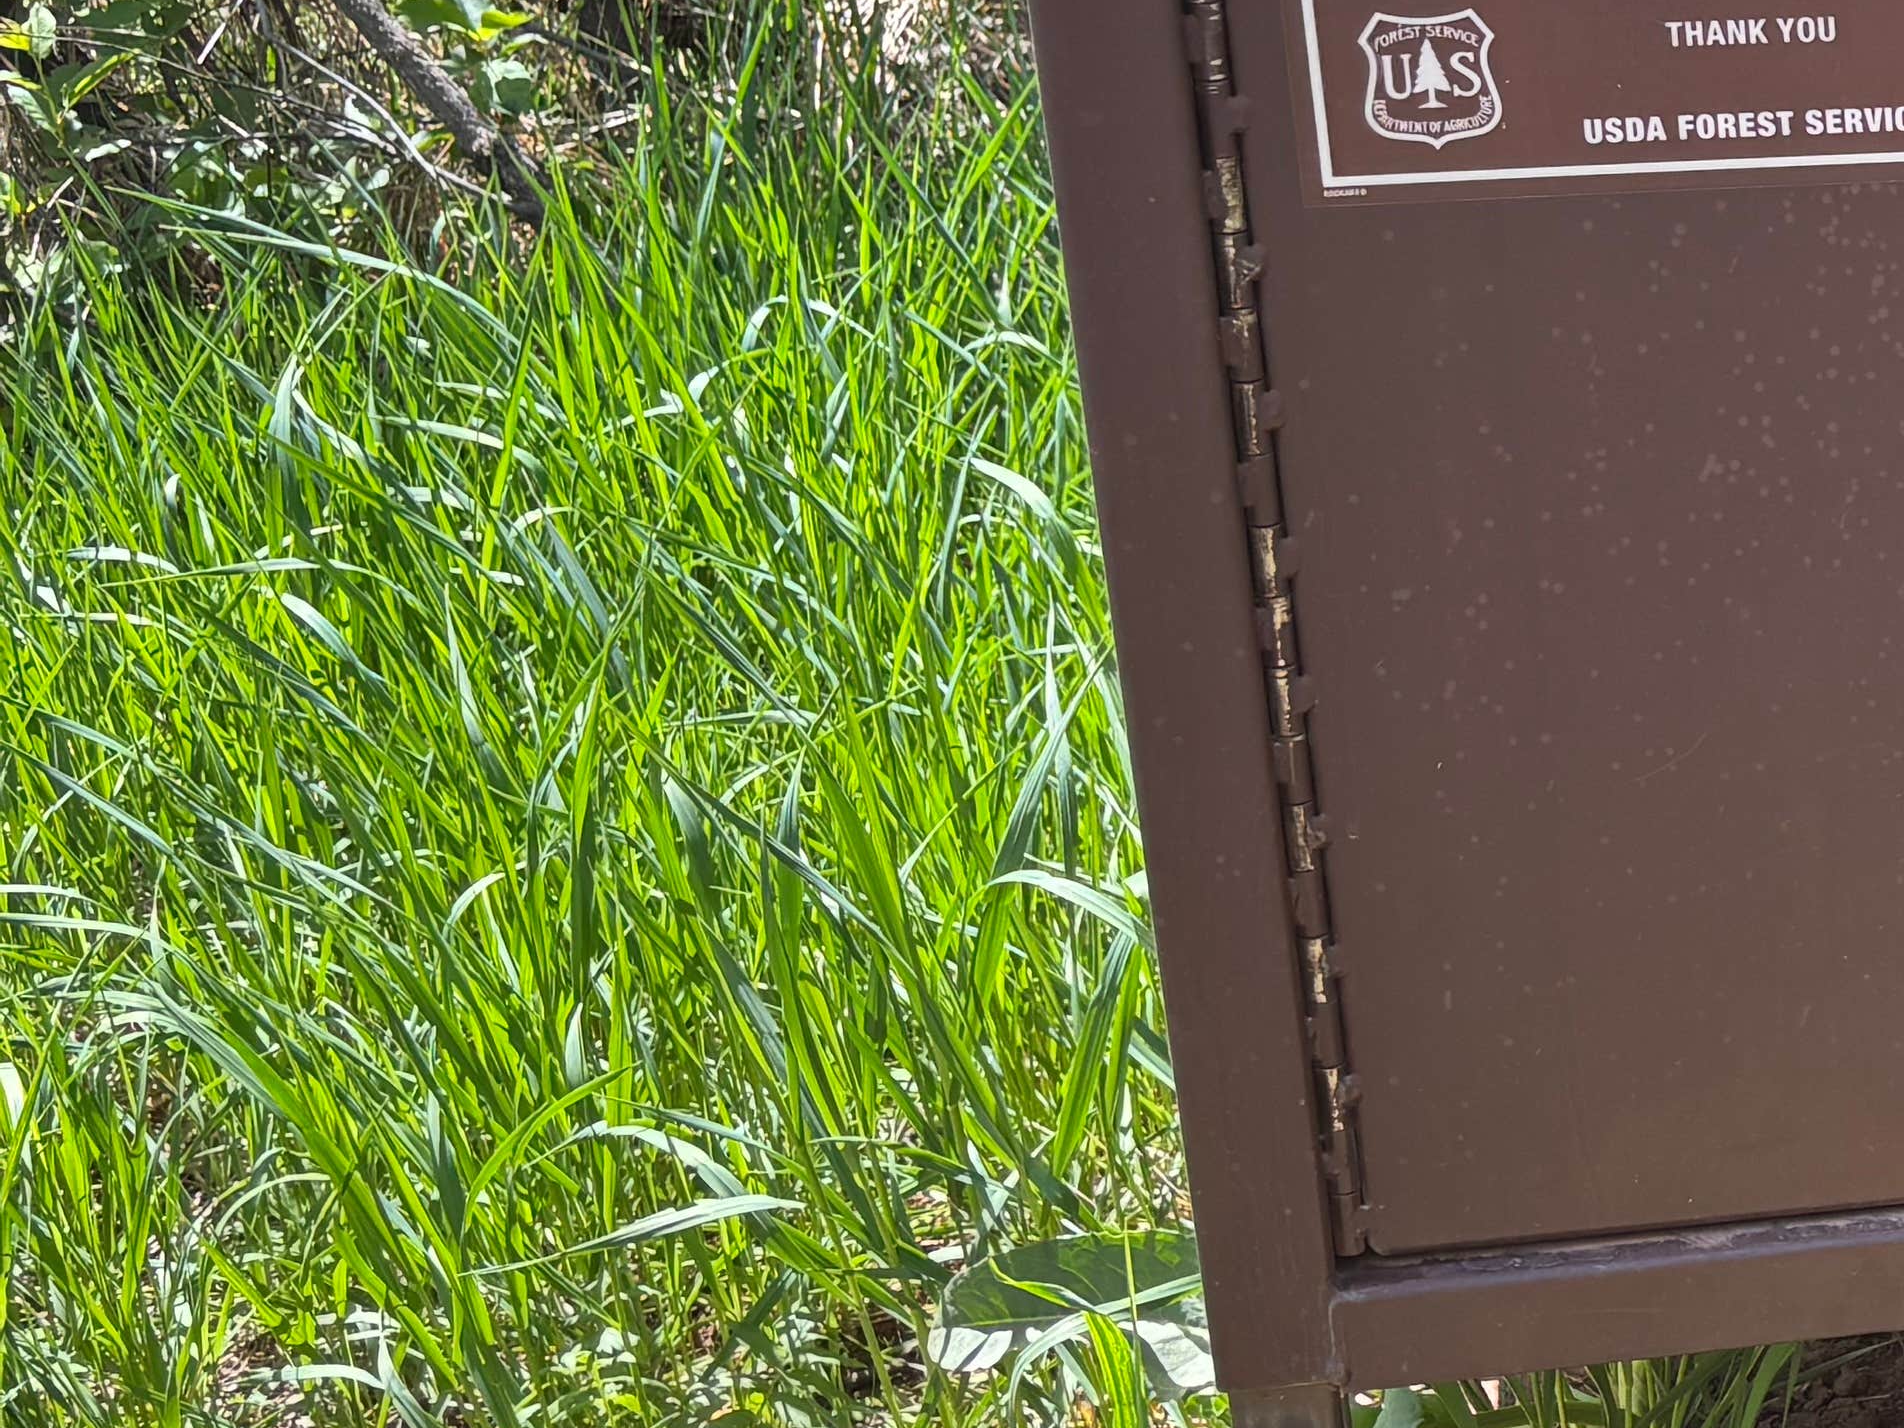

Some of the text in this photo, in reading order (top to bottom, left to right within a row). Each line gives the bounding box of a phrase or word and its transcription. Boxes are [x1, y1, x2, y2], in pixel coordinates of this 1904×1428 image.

[1374, 25, 1480, 52] FOREST SERVICE
[1664, 15, 1836, 47] THANK YOU
[1582, 115, 1667, 144] USDA
[1677, 110, 1794, 140] FOREST
